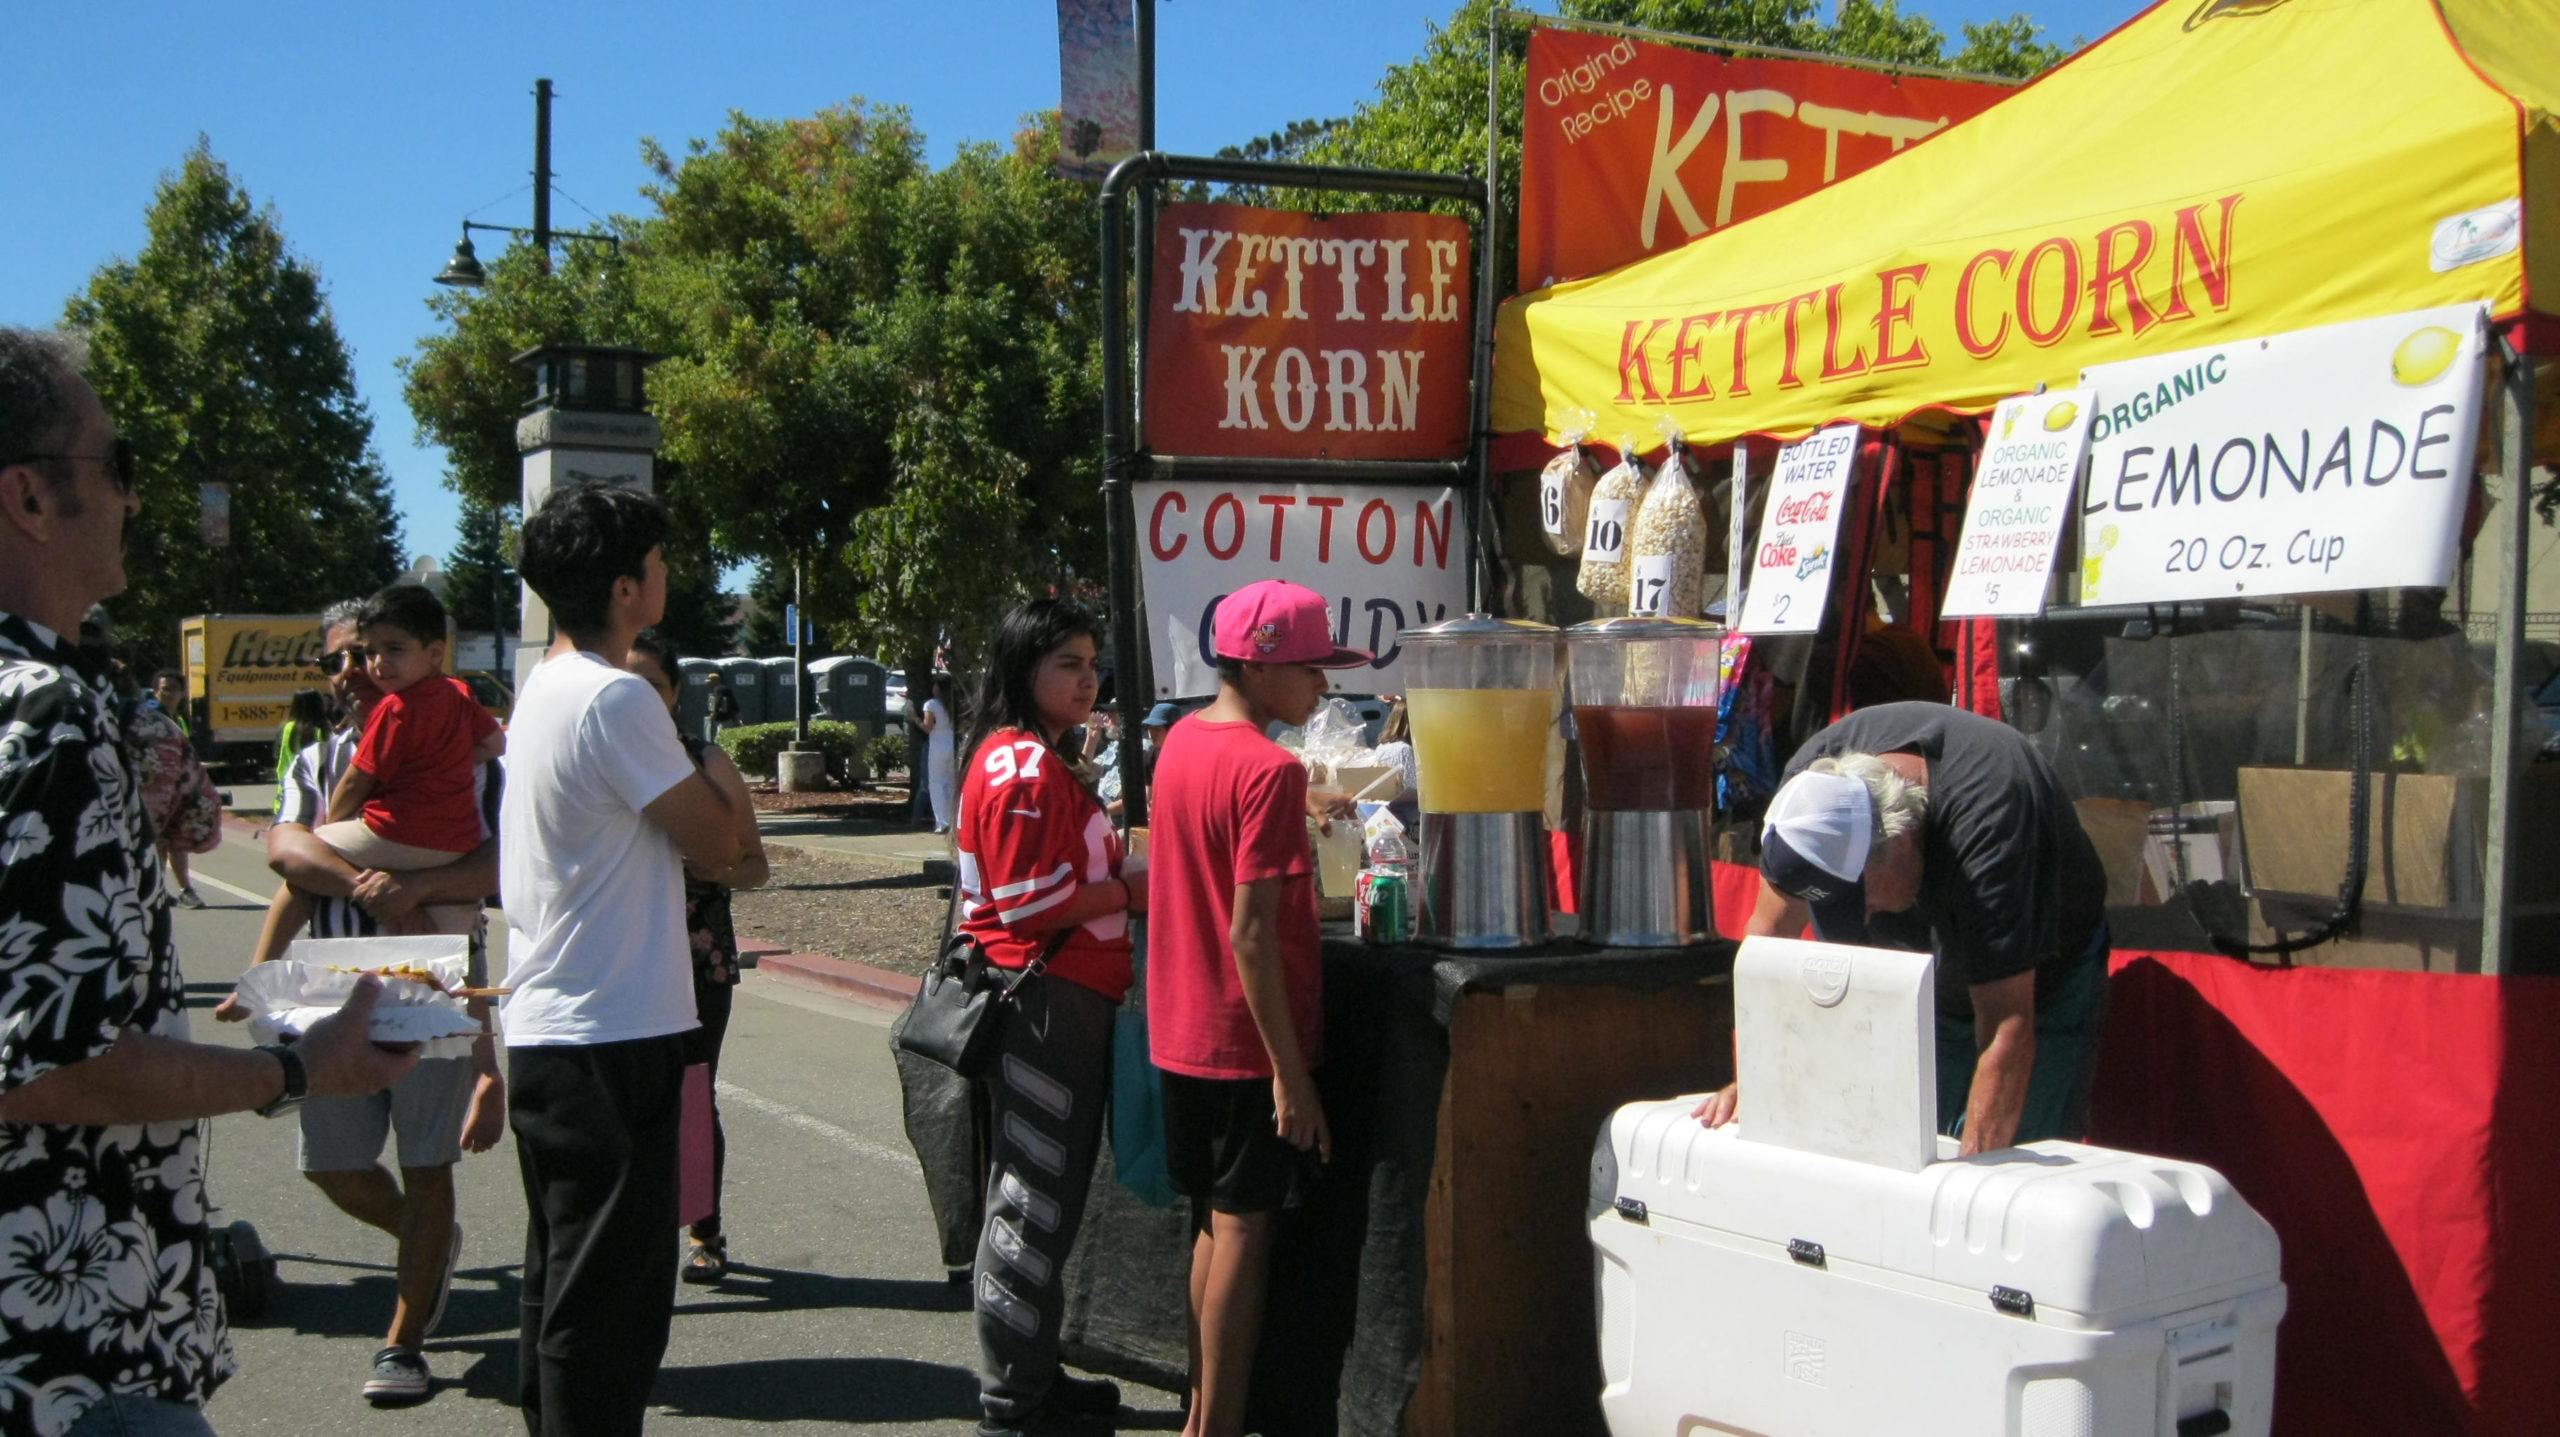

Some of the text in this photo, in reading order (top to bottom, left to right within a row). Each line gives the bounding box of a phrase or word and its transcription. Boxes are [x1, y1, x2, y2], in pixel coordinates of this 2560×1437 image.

[1539, 36, 1638, 107] Original
[1560, 75, 1653, 145] Recipe
[1173, 227, 1458, 322] KETTLE
[1613, 192, 2245, 405] KETTLE CORN
[1218, 344, 1425, 433] KORN
[2088, 352, 2229, 443] ORGANIC
[1781, 436, 1850, 464] BOTTLED
[1993, 440, 2068, 464] ORGANIC
[2083, 404, 2455, 516] LEMONADE
[1784, 460, 1837, 485] WATER
[1980, 463, 2070, 489] LEMONADE
[1544, 486, 1560, 527] 6
[2013, 490, 2024, 503] &
[1149, 490, 1453, 570] COTTON
[1978, 505, 2053, 528] ORGANIC
[1760, 542, 1797, 568] Coke
[1965, 530, 2057, 551] STRAWBERRY
[2165, 530, 2346, 573] 20 Oz. Cup
[1960, 553, 2048, 576] LEMONADE
[224, 630, 322, 667] Hert
[216, 670, 298, 683] Equipment
[985, 740, 1046, 786] 97
